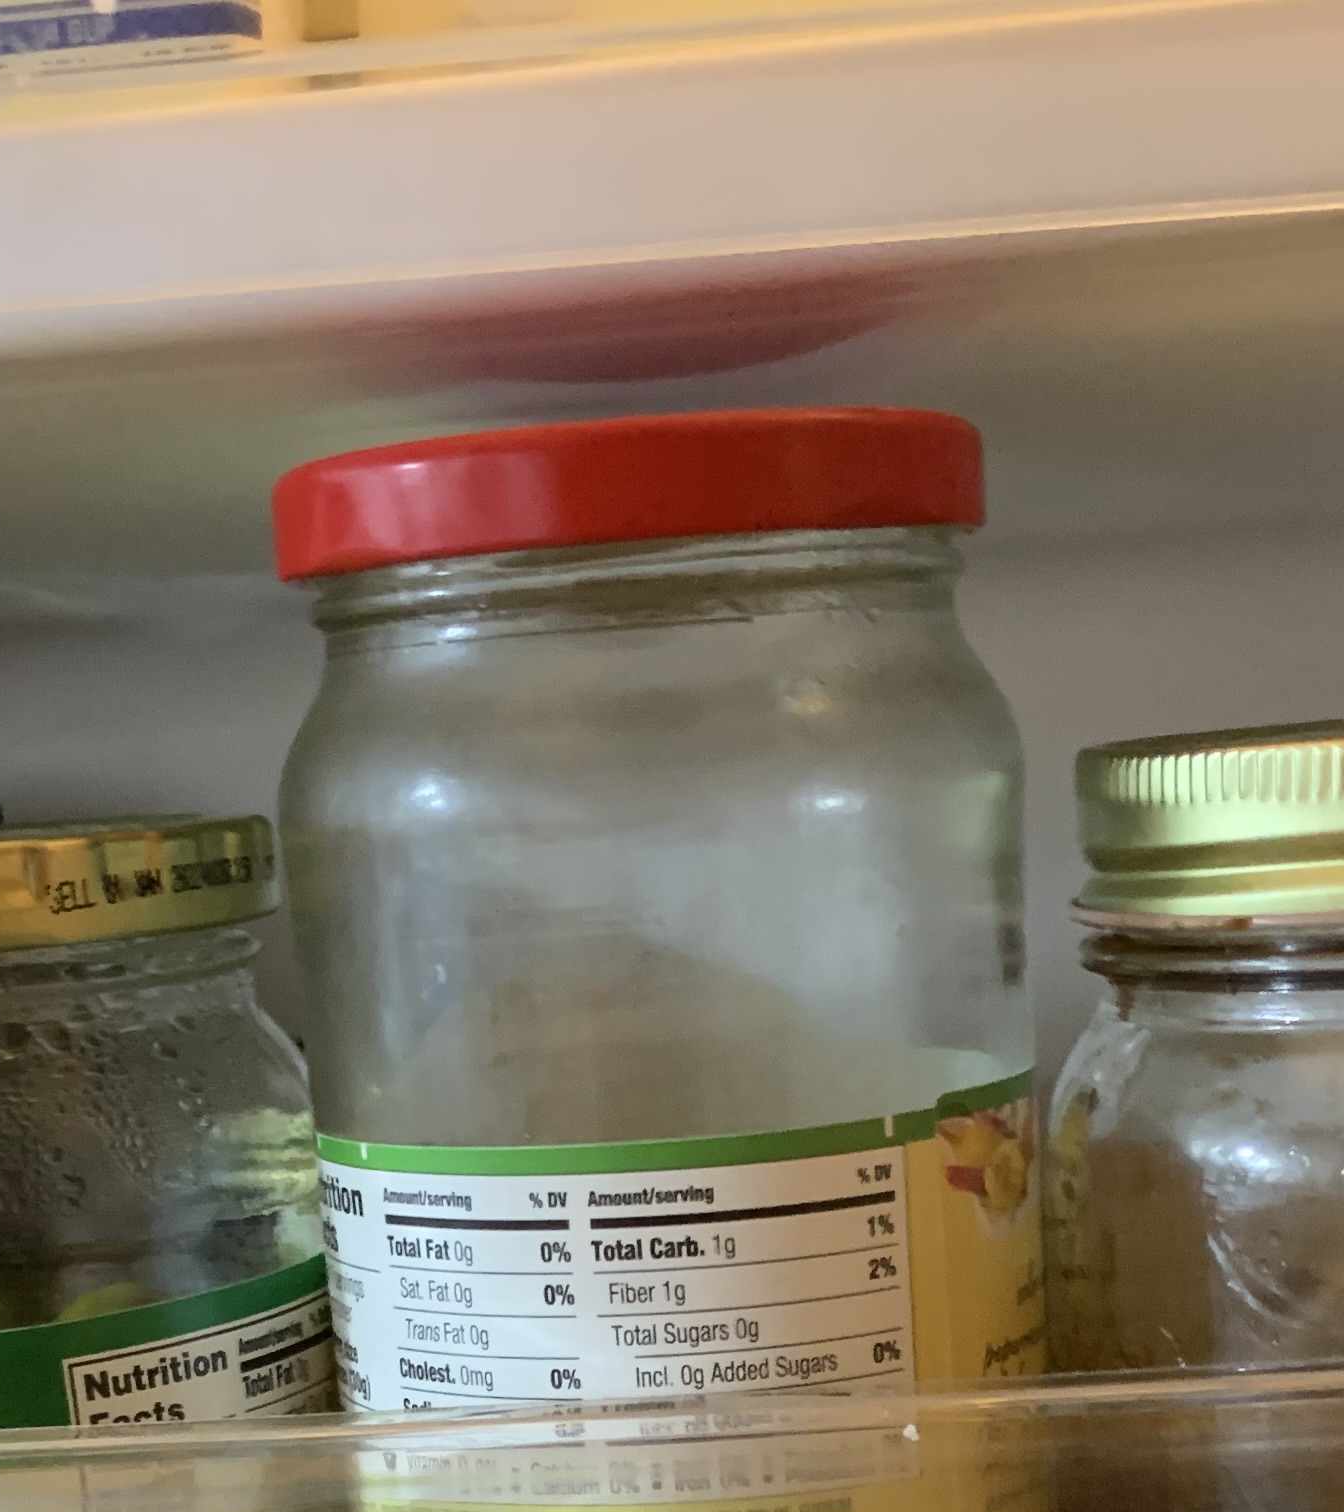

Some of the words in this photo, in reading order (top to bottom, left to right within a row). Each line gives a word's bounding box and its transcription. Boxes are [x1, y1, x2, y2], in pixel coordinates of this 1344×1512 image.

[383, 1187, 473, 1212] Amount/serving
[547, 1191, 568, 1209] DV
[587, 1185, 715, 1208] Amount/serving
[874, 1164, 892, 1181] DV
[387, 1235, 421, 1258] Total
[425, 1239, 449, 1261] Fat
[454, 1241, 473, 1266] 0g
[540, 1242, 571, 1263] 0%
[591, 1240, 642, 1262] Total
[649, 1236, 705, 1260] Carb.
[712, 1235, 736, 1258] 1g
[867, 1216, 894, 1238] 1%
[400, 1277, 423, 1300] Sat.
[428, 1280, 450, 1302] Fat
[454, 1284, 473, 1308] 0g
[543, 1284, 575, 1306] 0%
[608, 1282, 655, 1304] Fiber
[663, 1281, 686, 1305] 1g
[868, 1256, 897, 1281] 2%
[405, 1319, 441, 1343] Trans
[444, 1322, 465, 1345] Fat
[470, 1325, 489, 1350] 0g
[611, 1324, 657, 1347] Total
[664, 1322, 729, 1345] Sugars
[735, 1318, 759, 1342] 0g
[84, 1350, 229, 1401] Nutrition
[399, 1357, 456, 1385] Cholest.
[460, 1364, 494, 1391] 0mg
[550, 1368, 581, 1390] 0%
[636, 1366, 674, 1388] Incl.
[680, 1364, 704, 1389] 0g
[711, 1358, 769, 1382] Added
[775, 1353, 838, 1377] Sugars
[873, 1340, 900, 1364] 0%
[242, 1369, 274, 1399] Total
